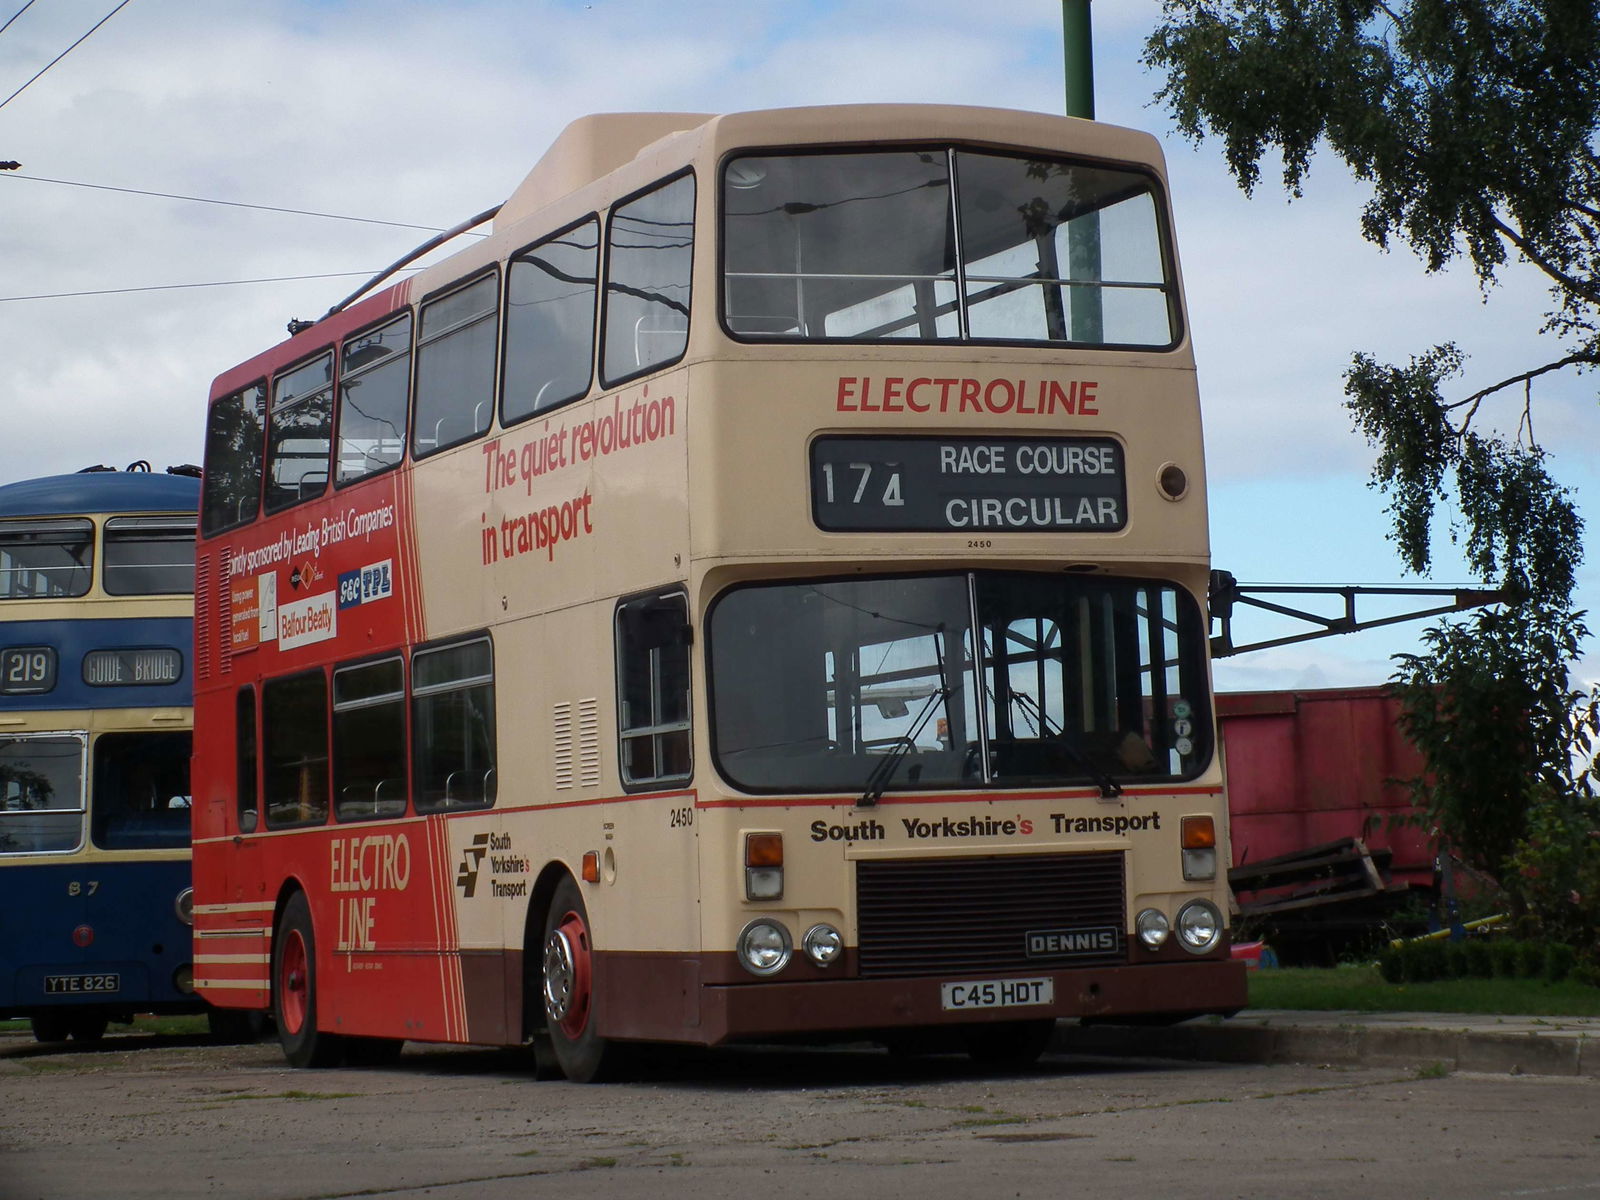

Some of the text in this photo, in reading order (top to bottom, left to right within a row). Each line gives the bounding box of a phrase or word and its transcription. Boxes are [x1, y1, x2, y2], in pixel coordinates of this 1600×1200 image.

[836, 377, 1099, 415] ELECTROLINE
[482, 383, 676, 497] The quiet revolution
[941, 446, 1116, 475] RACE COURSE
[482, 486, 593, 566] in transport
[945, 497, 1119, 527] CIRCULAR
[247, 532, 283, 576] sponsored
[283, 530, 294, 564] by
[293, 522, 321, 559] Leading
[320, 510, 346, 547] British
[347, 500, 394, 543] Companies
[967, 540, 992, 548] 2450
[281, 602, 333, 639] Balfour Beatty
[9, 654, 46, 682] 219
[88, 654, 175, 682] GUIDE BRIDGE
[671, 808, 693, 827] 2450
[811, 812, 1161, 841] South Yorkshire's Transport
[490, 832, 511, 850] South
[330, 833, 411, 892] ELECTRO
[490, 854, 530, 873] Yorkshire's
[491, 878, 527, 899] Transport
[338, 897, 376, 951] LINE
[1031, 932, 1113, 952] DENNIS
[49, 976, 116, 992] YTE 826
[951, 981, 1044, 1007] C45 HDT
